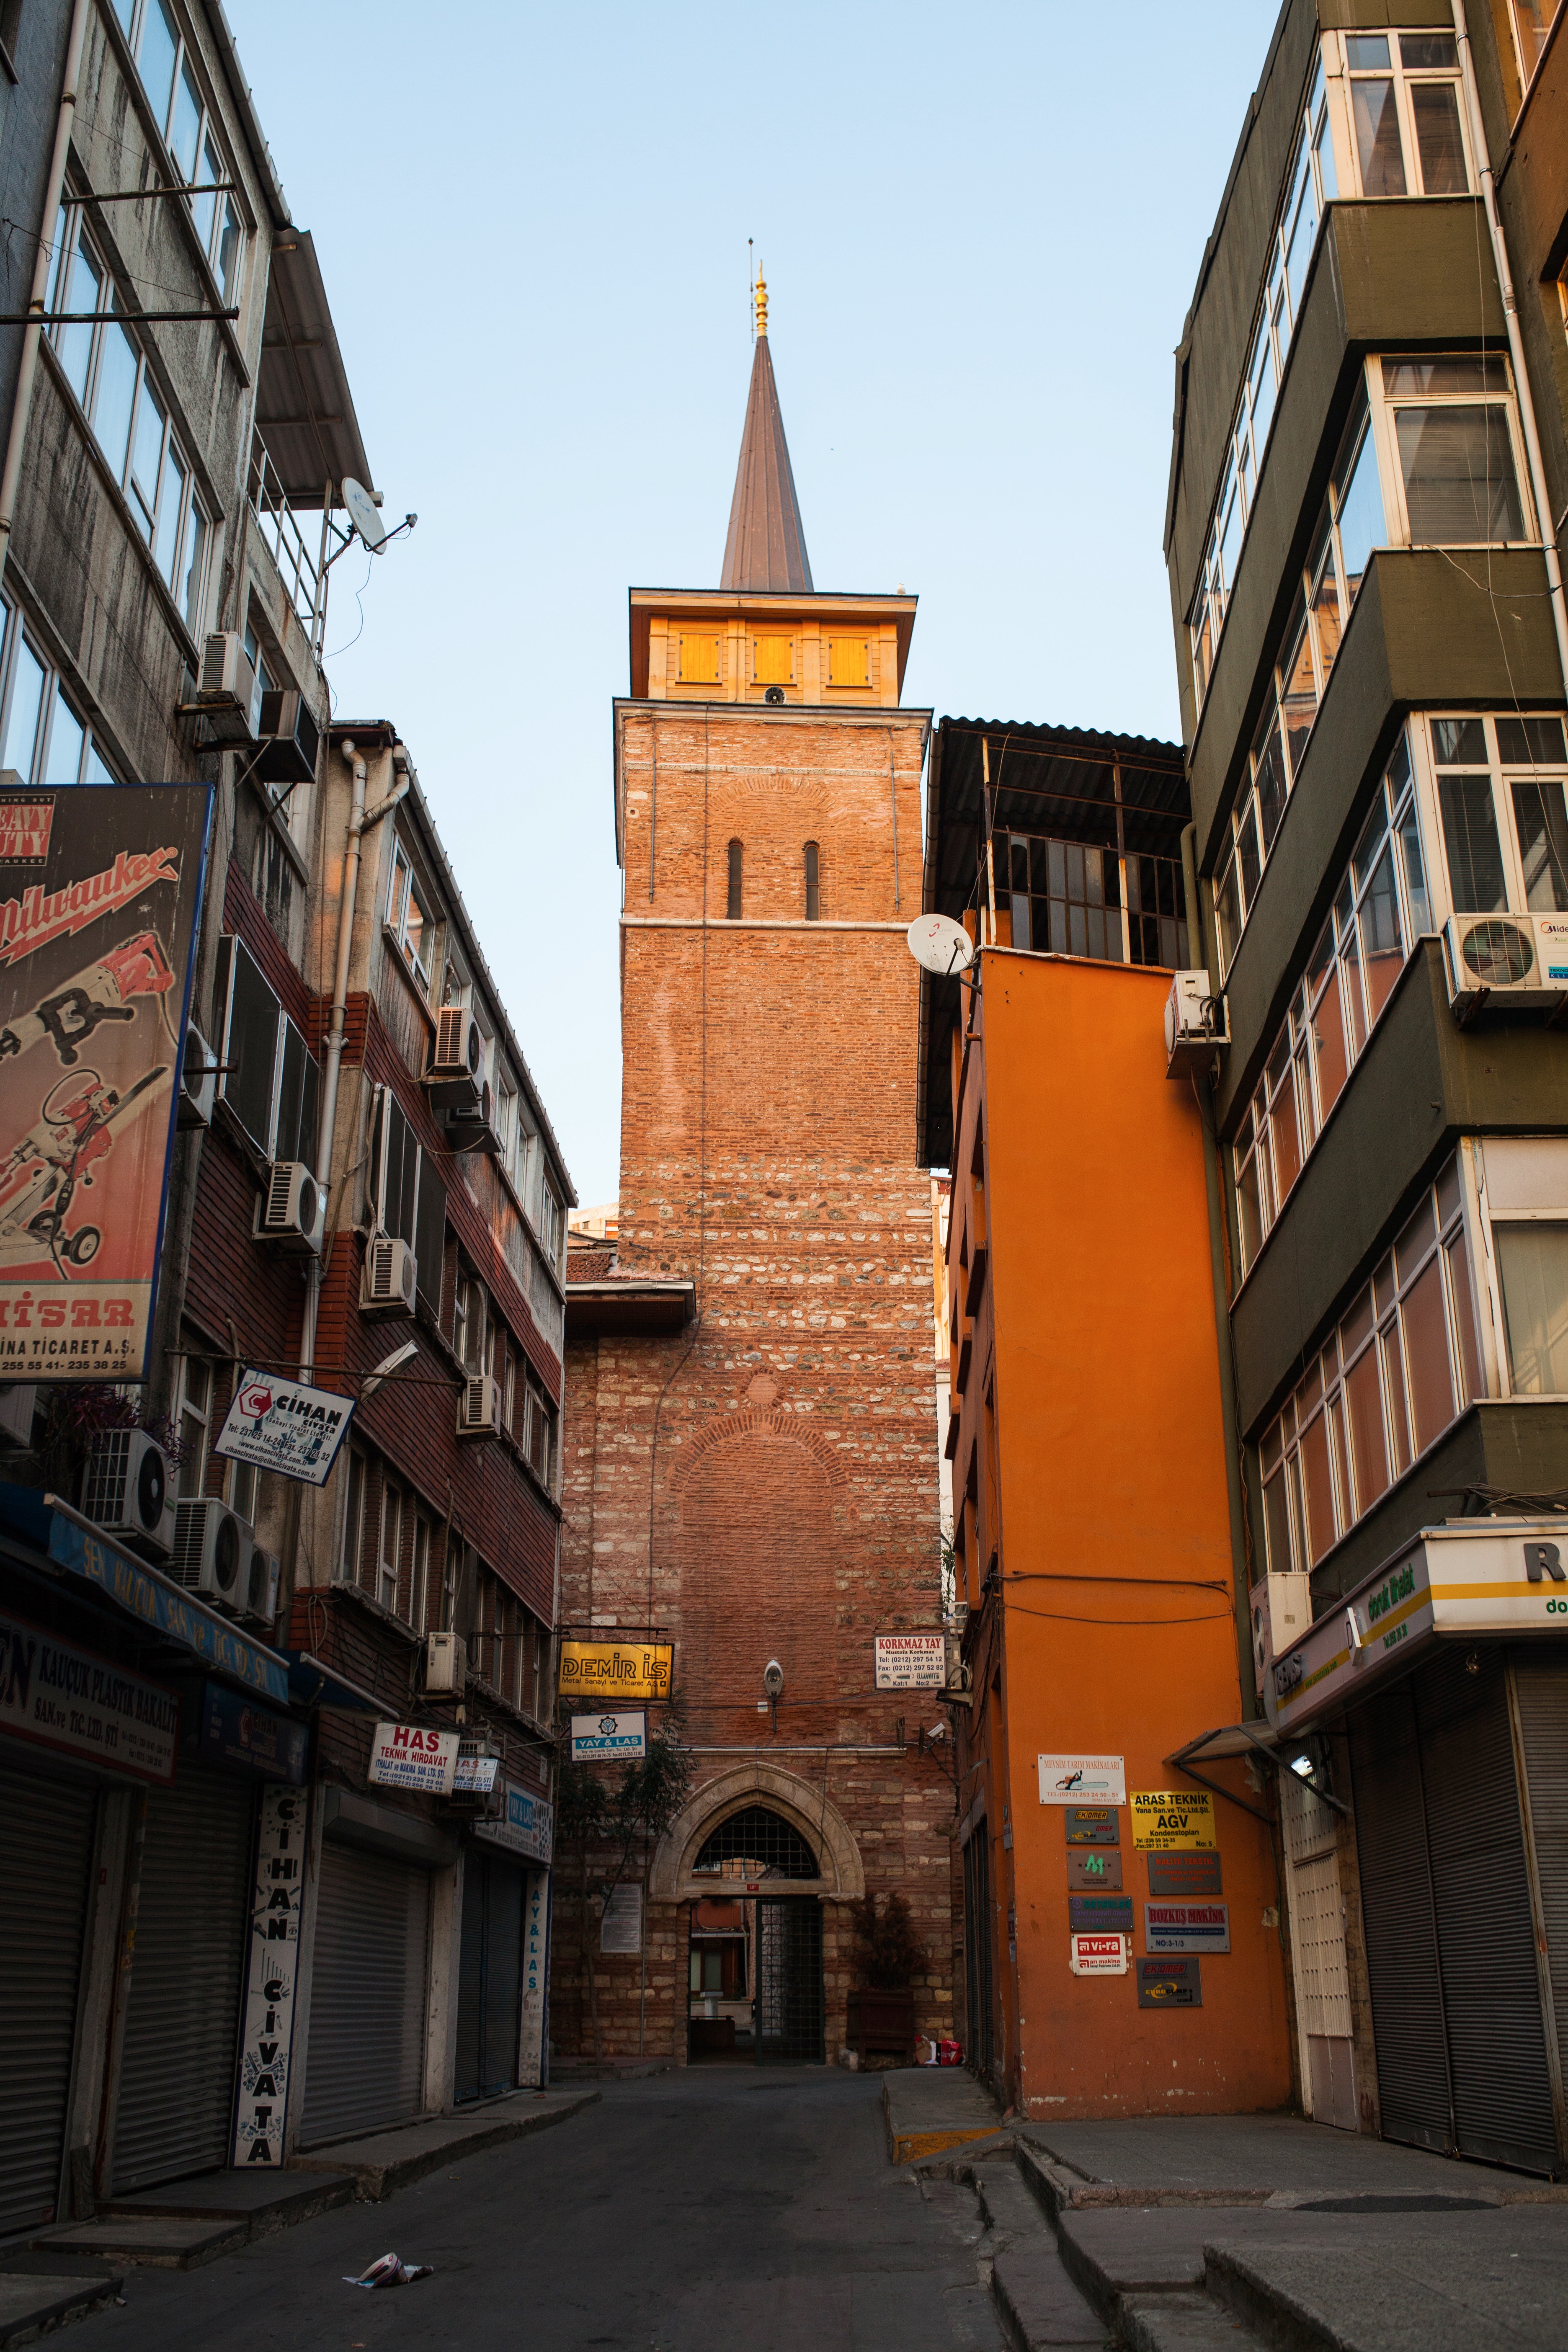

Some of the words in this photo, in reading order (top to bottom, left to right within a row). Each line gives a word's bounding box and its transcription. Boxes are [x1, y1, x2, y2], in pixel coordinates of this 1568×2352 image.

[33, 1336, 99, 1354] TİCARET
[103, 1339, 135, 1358] A.Ş.
[67, 1361, 89, 1369] 235
[277, 1395, 342, 1426] CİHAN
[268, 1417, 288, 1428] Sanayi
[228, 1423, 238, 1433] Tel:
[240, 1427, 253, 1437] 237
[253, 1430, 262, 1440] 25
[298, 1445, 311, 1456] 237
[311, 1449, 320, 1459] 21
[321, 1452, 330, 1462] 32
[240, 1441, 308, 1467] www.cihancivata.com.tr
[225, 1445, 317, 1479] cihancivata@cihancivata.com.tr
[879, 1638, 923, 1649] KORKMAZ
[925, 1638, 941, 1648] YAY
[563, 1653, 636, 1678] DEMİR
[585, 1678, 607, 1686] Sanayi
[393, 1726, 439, 1752] HAS
[579, 1739, 601, 1748] YAY
[616, 1737, 639, 1746] LAS
[411, 1751, 448, 1767] HIRDAVAT
[1044, 1758, 1066, 1769] MEVSİM
[1067, 1760, 1085, 1769] TARIM
[1086, 1759, 1120, 1769] MAKİNALARI
[1135, 1795, 1165, 1805] ARAS
[1168, 1792, 1209, 1805] TEKNİK
[1157, 1815, 1188, 1828] AGV
[1084, 1900, 1131, 1909] ORTAKLAR
[1149, 1908, 1187, 1925] BOZKUŞ
[1187, 1906, 1225, 1924] MAKİNA
